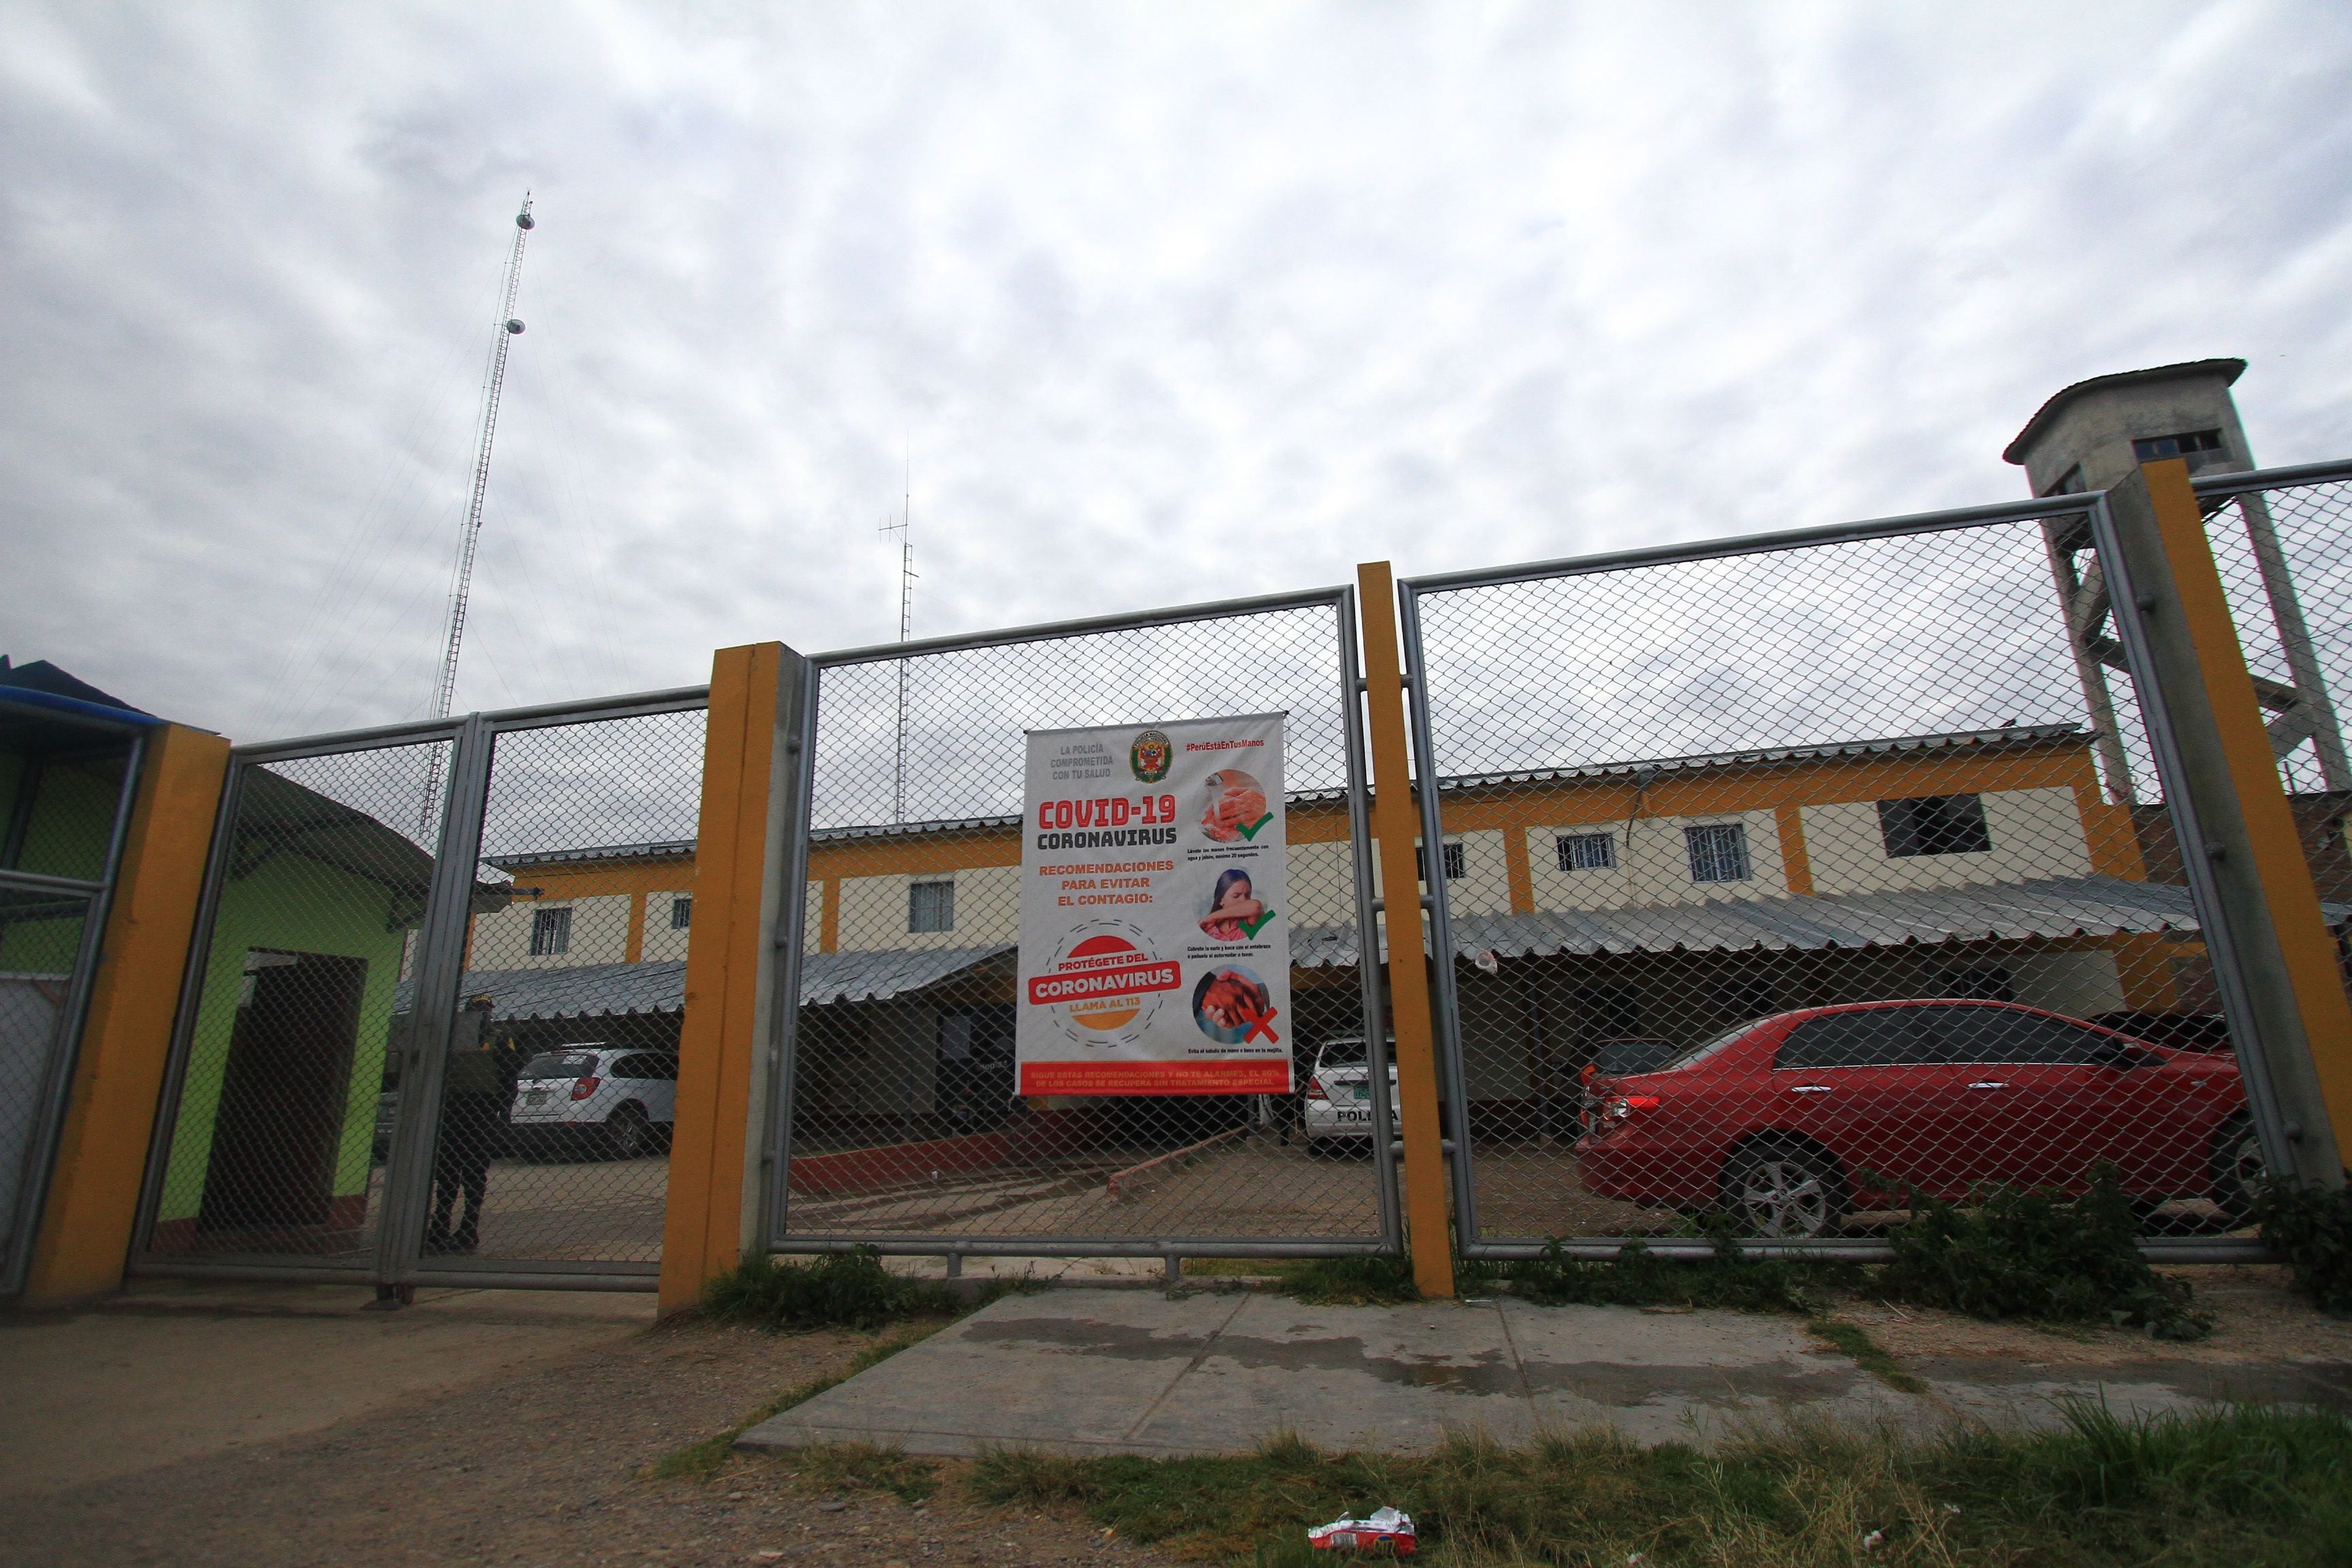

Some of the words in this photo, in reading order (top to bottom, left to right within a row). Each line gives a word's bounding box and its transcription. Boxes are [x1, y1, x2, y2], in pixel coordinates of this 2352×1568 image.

[1060, 746, 1070, 755] LA
[1073, 741, 1103, 754] POLICÍA
[1186, 739, 1264, 751] #PerúEstáEnTusManos
[1051, 755, 1113, 768] COMPROMETIDA
[1053, 770, 1069, 780] CON
[1072, 770, 1082, 779] TU
[1085, 768, 1110, 778] SALUD
[1039, 794, 1175, 830] COVID-19
[1038, 828, 1177, 850] CORONAVIRUS
[1039, 860, 1174, 876] RECOMENDACIONES
[1062, 880, 1096, 890] PARA
[1100, 878, 1150, 889] EVITAR
[1058, 896, 1074, 906] EL
[1078, 894, 1153, 905] CONTAGIO:
[1058, 956, 1123, 971] PROTÉGETE
[1127, 953, 1149, 963] DEL
[1036, 968, 1174, 998] CORONAVIRUS
[1069, 1001, 1107, 1013] LLAMA
[1109, 999, 1123, 1008] AL
[1126, 997, 1141, 1006] 113
[1337, 1110, 1399, 1122] POLIA
